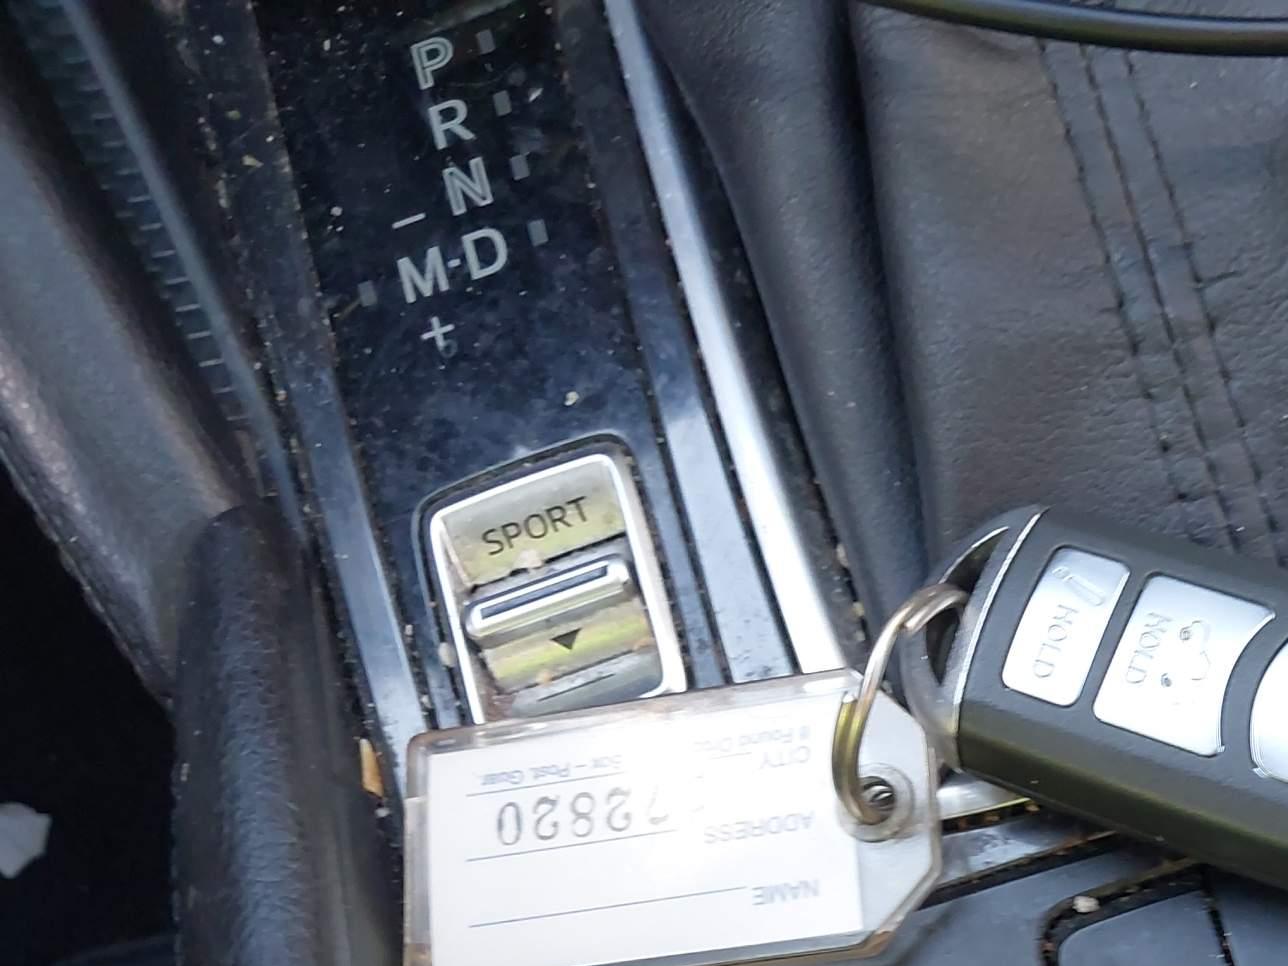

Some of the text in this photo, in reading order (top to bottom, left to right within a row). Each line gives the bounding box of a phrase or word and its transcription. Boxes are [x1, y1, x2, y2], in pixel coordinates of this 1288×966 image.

[410, 36, 455, 90] P
[427, 99, 476, 150] R
[442, 156, 494, 217] N
[481, 495, 588, 556] SPORT
[1032, 603, 1079, 679] HOLD
[1125, 611, 1173, 685] HOLD
[759, 745, 812, 770] CITY
[497, 785, 704, 847] 72820
[703, 810, 816, 845] ADDRESS
[752, 878, 820, 907] NAME
